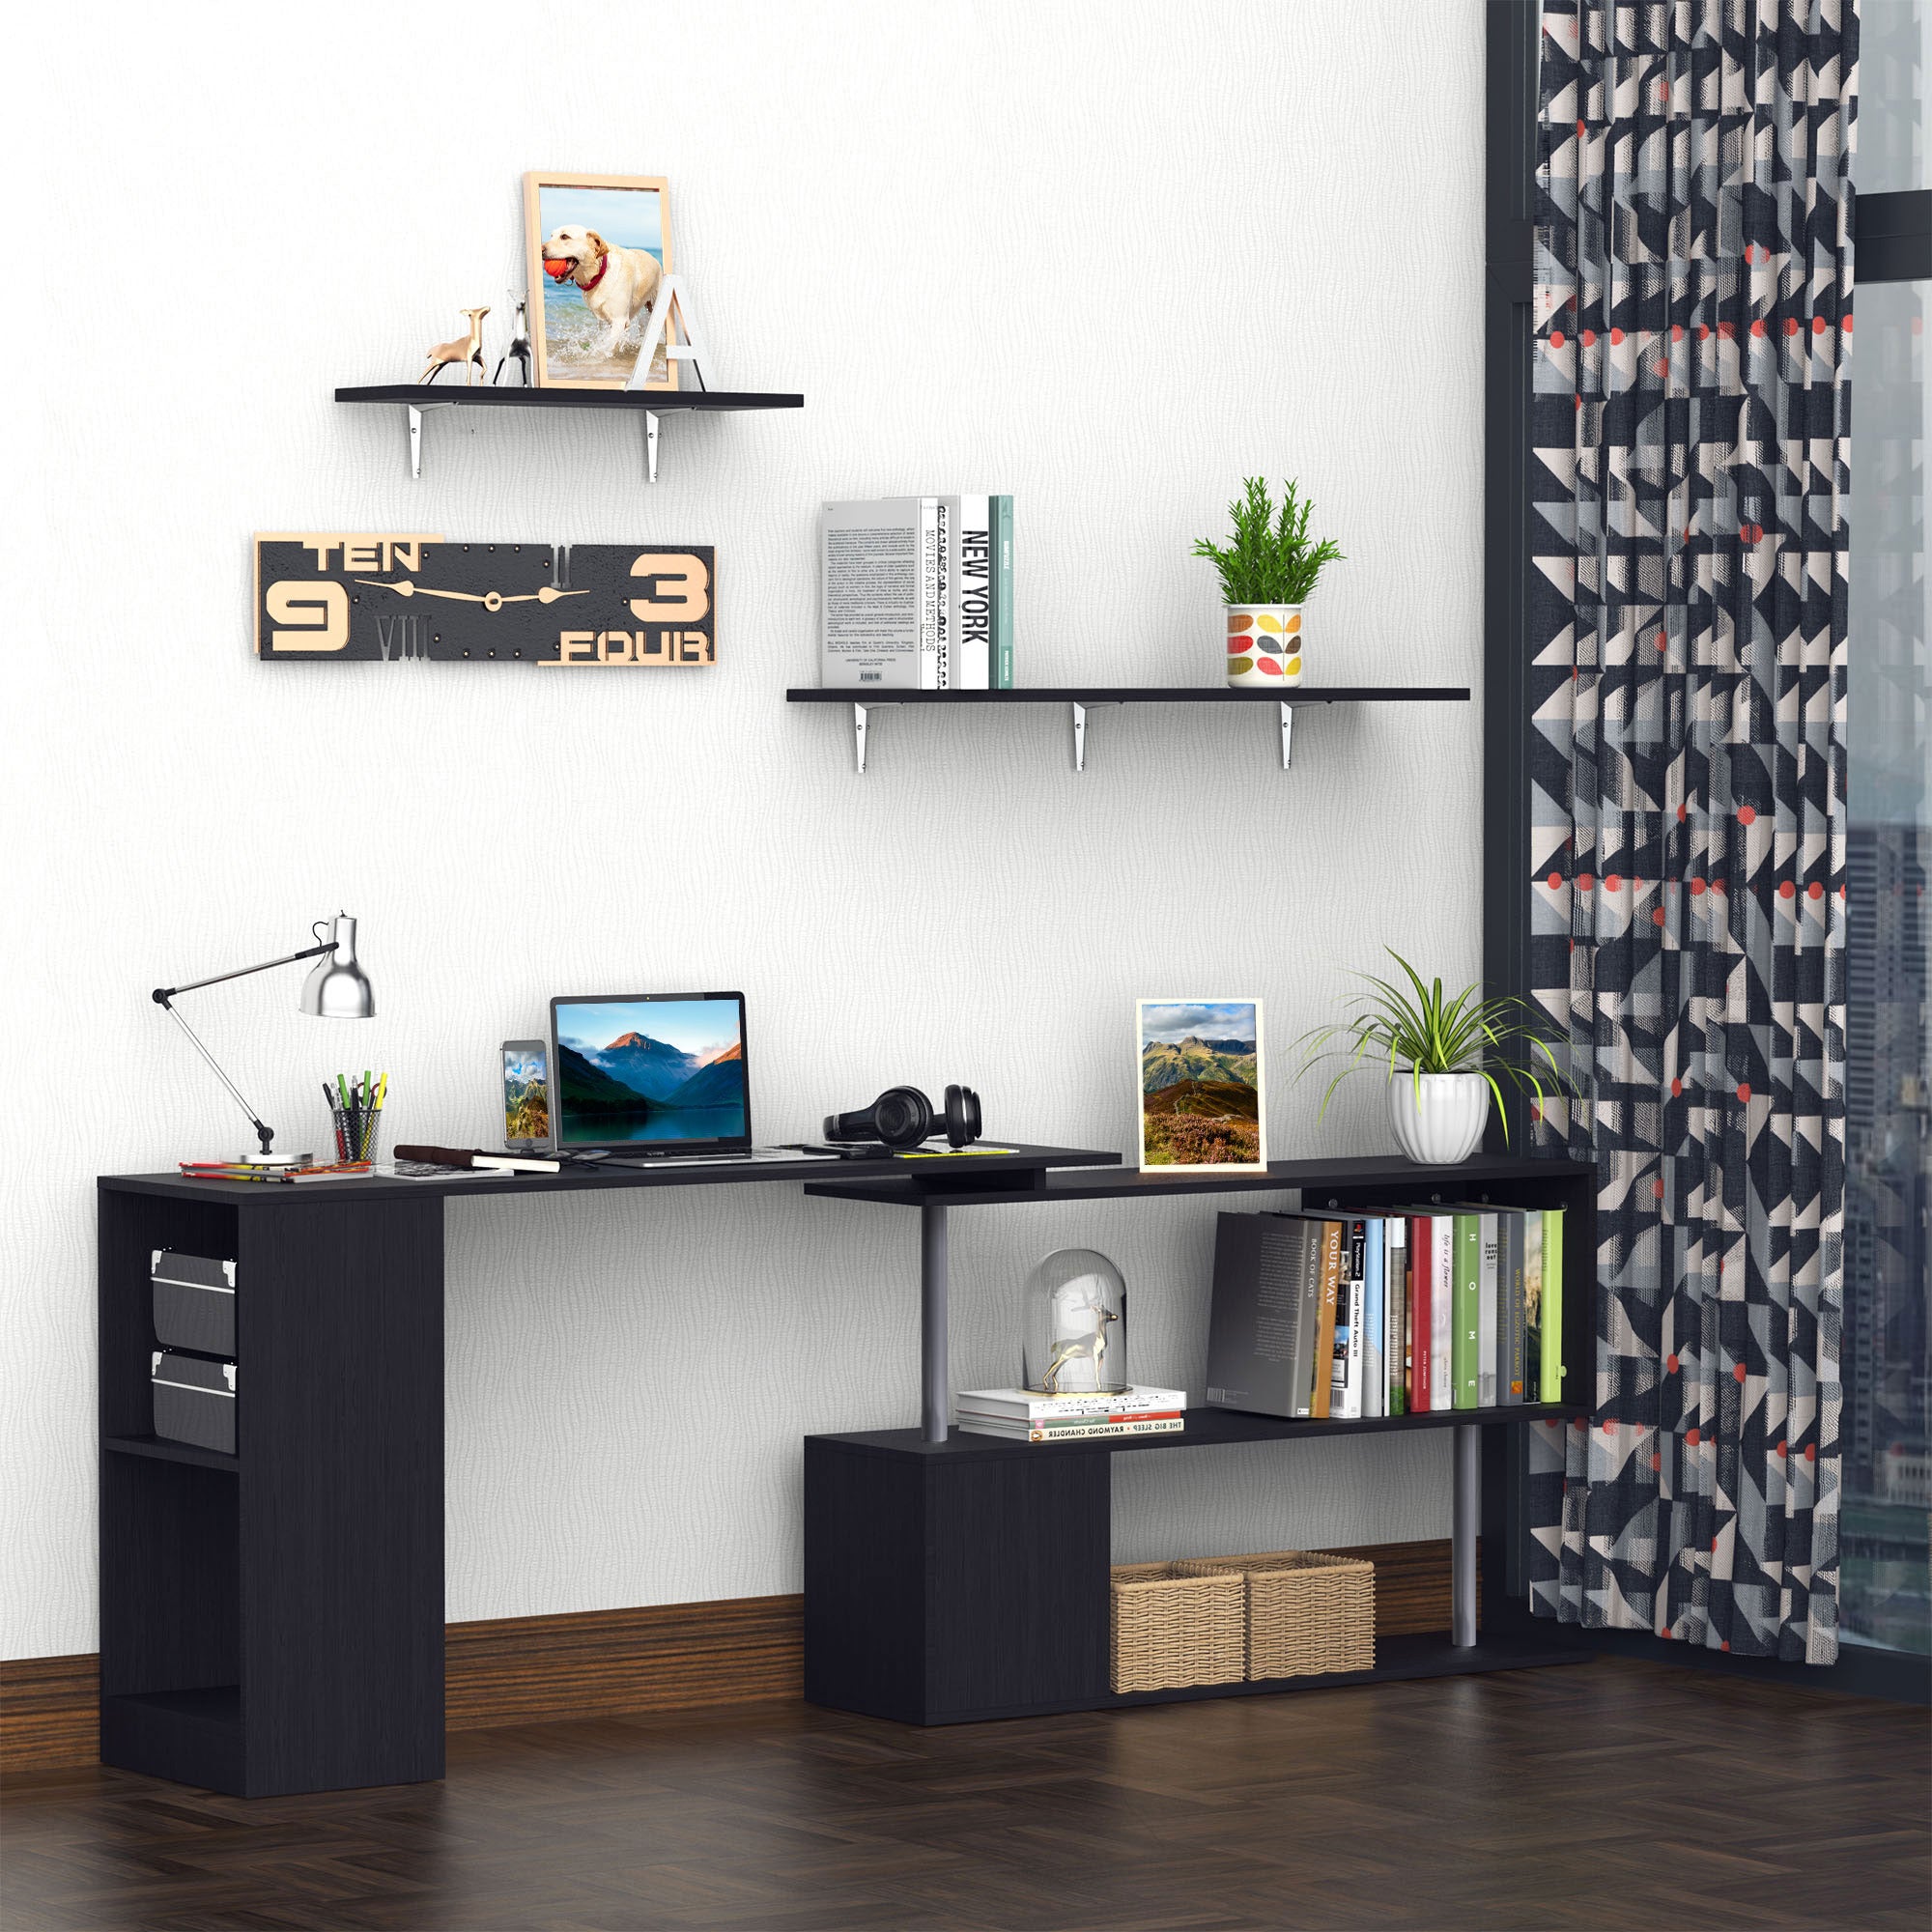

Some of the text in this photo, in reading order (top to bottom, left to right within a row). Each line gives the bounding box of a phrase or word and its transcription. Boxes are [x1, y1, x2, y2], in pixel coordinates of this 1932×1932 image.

[302, 541, 422, 572] TEN
[629, 553, 711, 622] 3
[925, 529, 936, 652] MOVIES AND METHODS
[962, 530, 989, 644] NEW YORK
[266, 581, 351, 652] 9
[375, 614, 431, 661] VIII
[559, 630, 712, 663] FOUR
[1309, 1238, 1318, 1262] BOOK
[1309, 1264, 1316, 1275] OF
[1325, 1231, 1339, 1306] YOUR WAY
[1440, 1265, 1450, 1288] flower
